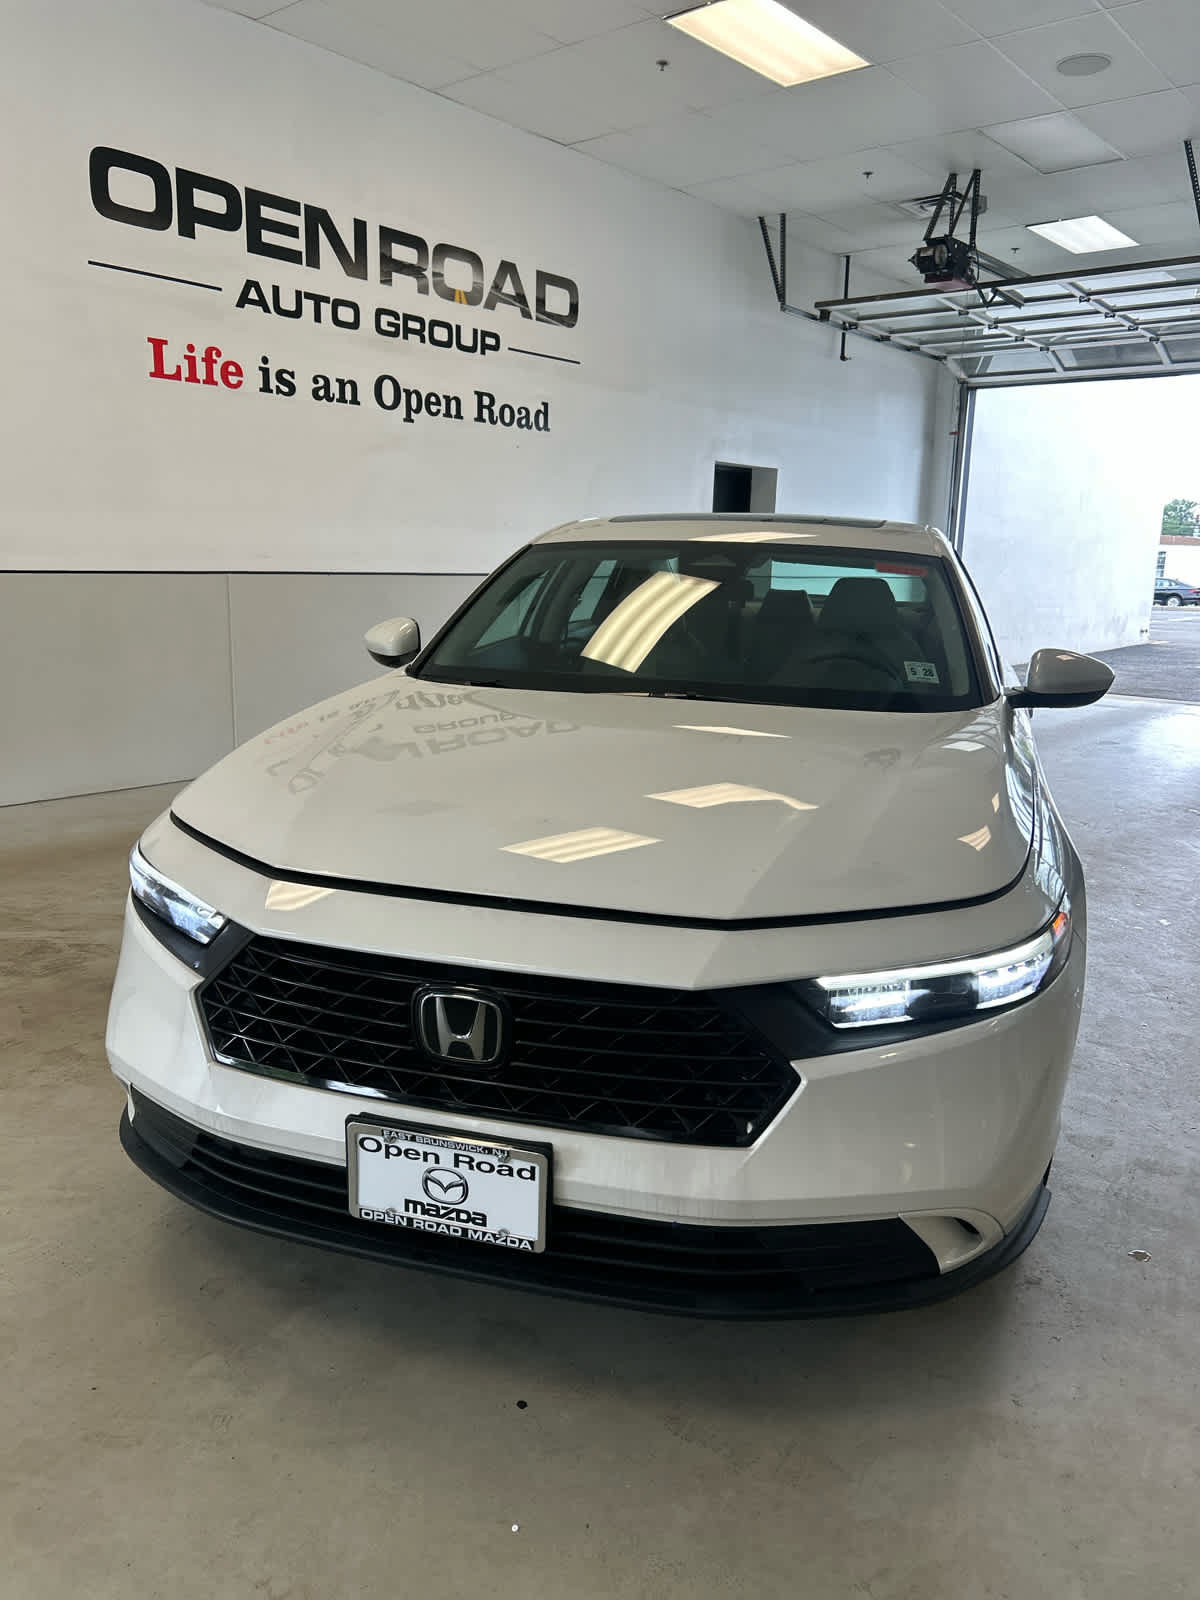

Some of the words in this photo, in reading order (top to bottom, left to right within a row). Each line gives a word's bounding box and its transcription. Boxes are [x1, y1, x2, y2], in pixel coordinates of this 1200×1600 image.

[235, 279, 360, 330] AUTO
[374, 307, 501, 355] GROUP
[147, 336, 244, 389] Life
[258, 356, 297, 396] is
[311, 373, 361, 406] an
[373, 374, 464, 423] Open
[473, 390, 551, 432] Road
[359, 1136, 441, 1165] Open
[453, 1152, 537, 1182] Road
[383, 1129, 412, 1141] EAST
[416, 1136, 489, 1154] BRUNSWICK,
[361, 1208, 408, 1226] OPEN
[412, 1219, 462, 1237] ROAD
[467, 1230, 533, 1251] MAZDA
[404, 1198, 488, 1228] mazda
